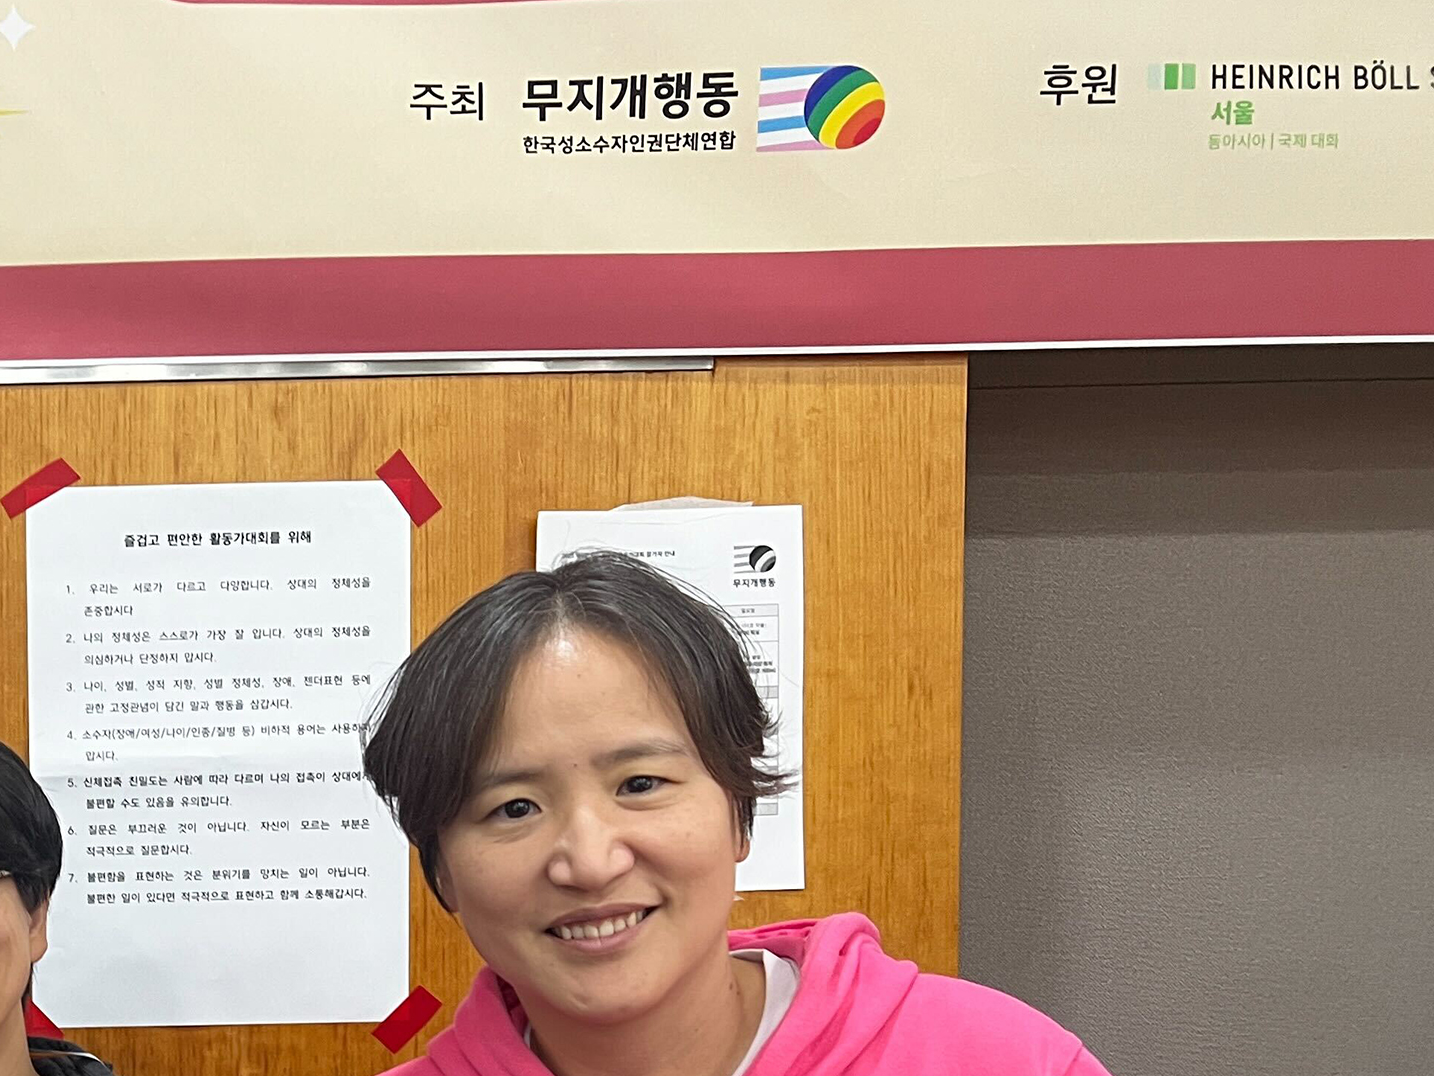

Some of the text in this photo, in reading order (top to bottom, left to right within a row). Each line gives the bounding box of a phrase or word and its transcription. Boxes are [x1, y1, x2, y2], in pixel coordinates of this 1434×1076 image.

[1211, 63, 1340, 90] HEINRICH
[1353, 59, 1420, 90] BÖLL
[1040, 63, 1117, 106] 후원
[409, 81, 485, 122] 주최
[522, 71, 739, 122] 무지개행동
[1211, 100, 1255, 125] 서울
[523, 129, 736, 154] 한국성소수자인권단체연합
[1208, 132, 1339, 150] 동아시아 국제 대화
[124, 530, 312, 548] 즐겁고 편안한 활동가대회를 위해
[89, 583, 119, 594] 우리는
[133, 582, 163, 593] 서로가
[177, 581, 207, 592] 다르고
[220, 579, 273, 591] 다양합니다.
[287, 578, 317, 590] 상대의
[332, 576, 371, 589] 정체성을
[733, 578, 776, 588] 무지개행동
[84, 605, 133, 617] 존중합시다
[83, 632, 103, 643] 나의
[112, 630, 151, 643] 정체성은
[159, 630, 198, 641] 스스로가
[207, 629, 226, 641] 가장
[293, 627, 323, 639] 상대의
[332, 625, 371, 638] 정체성을
[84, 653, 133, 665] 의심하거나
[139, 652, 179, 664] 단정하지
[146, 679, 165, 691] 성적
[204, 678, 223, 690] 성별
[304, 675, 343, 687] 젠더표현
[351, 674, 371, 686] 등에
[85, 702, 105, 714] 관한
[110, 701, 159, 713] 고정관념이
[165, 701, 184, 712] 담긴
[215, 699, 244, 711] 행동을
[261, 725, 290, 735] 비하적
[297, 724, 326, 735] 용어는
[67, 771, 367, 788] 5. 신체접촉 친밀도는 사람에 따라 다르며 나의 접촉이 상대에
[86, 795, 232, 810] 불편할 수도 있음을 유의합니다.
[88, 824, 117, 836] 질문은
[128, 823, 167, 835] 부끄러운
[178, 822, 197, 834] 것이
[207, 822, 249, 833] 아닙니다.
[260, 820, 290, 832] 자신이
[300, 819, 330, 831] 모르는
[340, 818, 370, 830] 부분은
[86, 843, 192, 857] 적극적으로 질문합시다.
[87, 871, 126, 883] 불편함을
[135, 870, 174, 882] 표현하는
[183, 869, 203, 881] 것은
[212, 868, 251, 880] 분위기를
[259, 868, 290, 880] 망치는
[298, 867, 318, 879] 일이
[327, 866, 370, 878] 아닙니다.
[86, 888, 367, 905] 불편한 일이 있다면 적극적으로 표현하고 함께 소통해갑시다.
